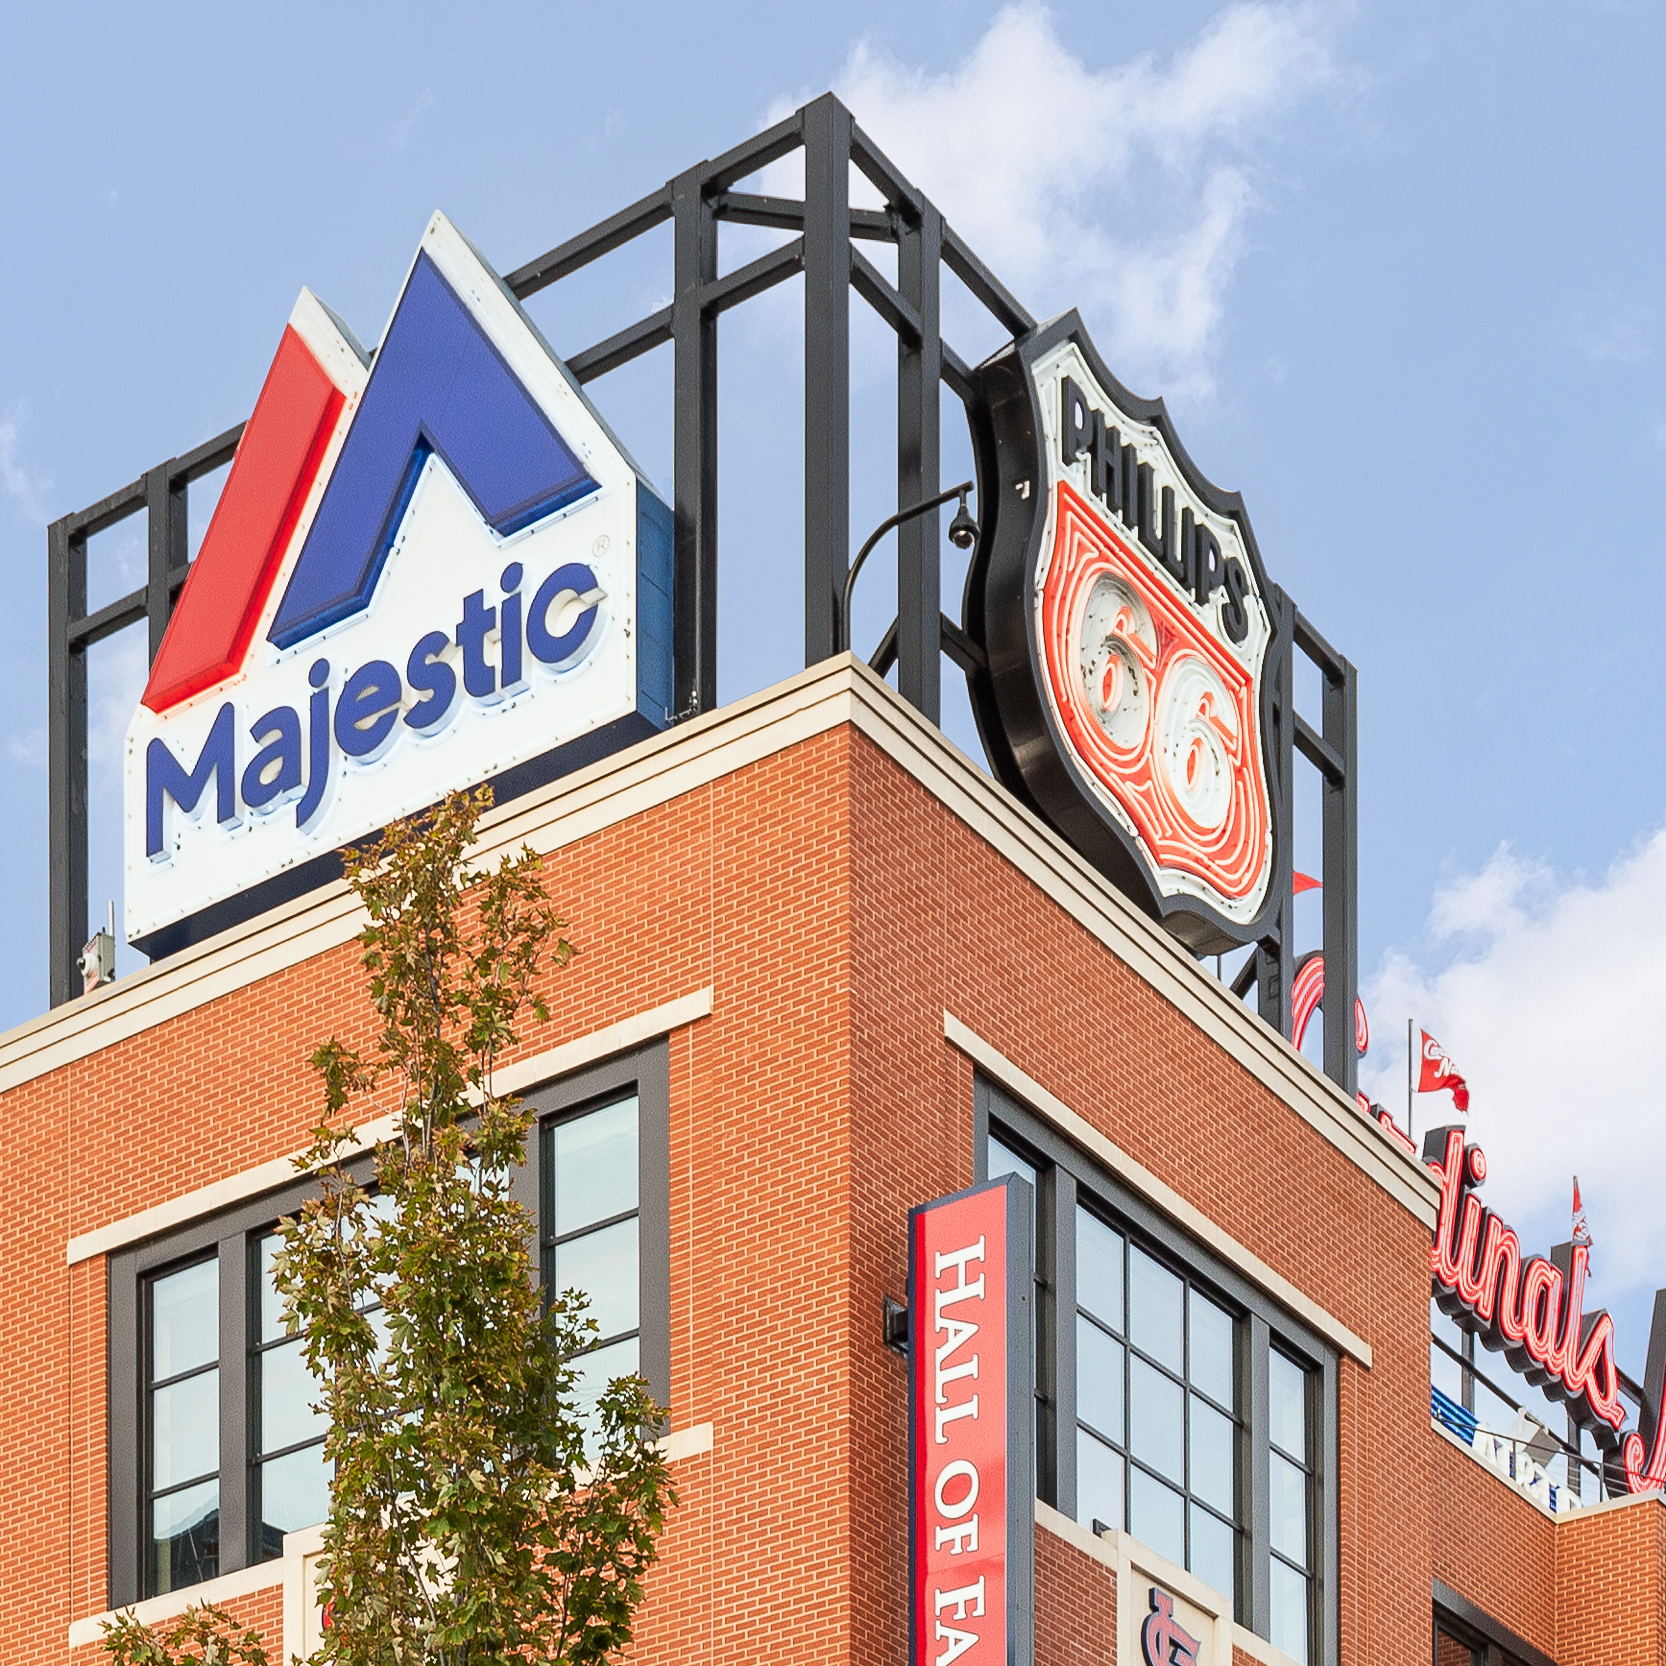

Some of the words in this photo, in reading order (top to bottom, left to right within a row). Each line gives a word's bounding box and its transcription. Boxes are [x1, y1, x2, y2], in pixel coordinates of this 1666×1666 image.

[1061, 375, 1249, 645] PHILLIPS
[144, 559, 606, 863] Majestic
[1079, 570, 1236, 830] 66
[934, 1235, 985, 1445] HALL
[934, 1460, 980, 1556] OF
